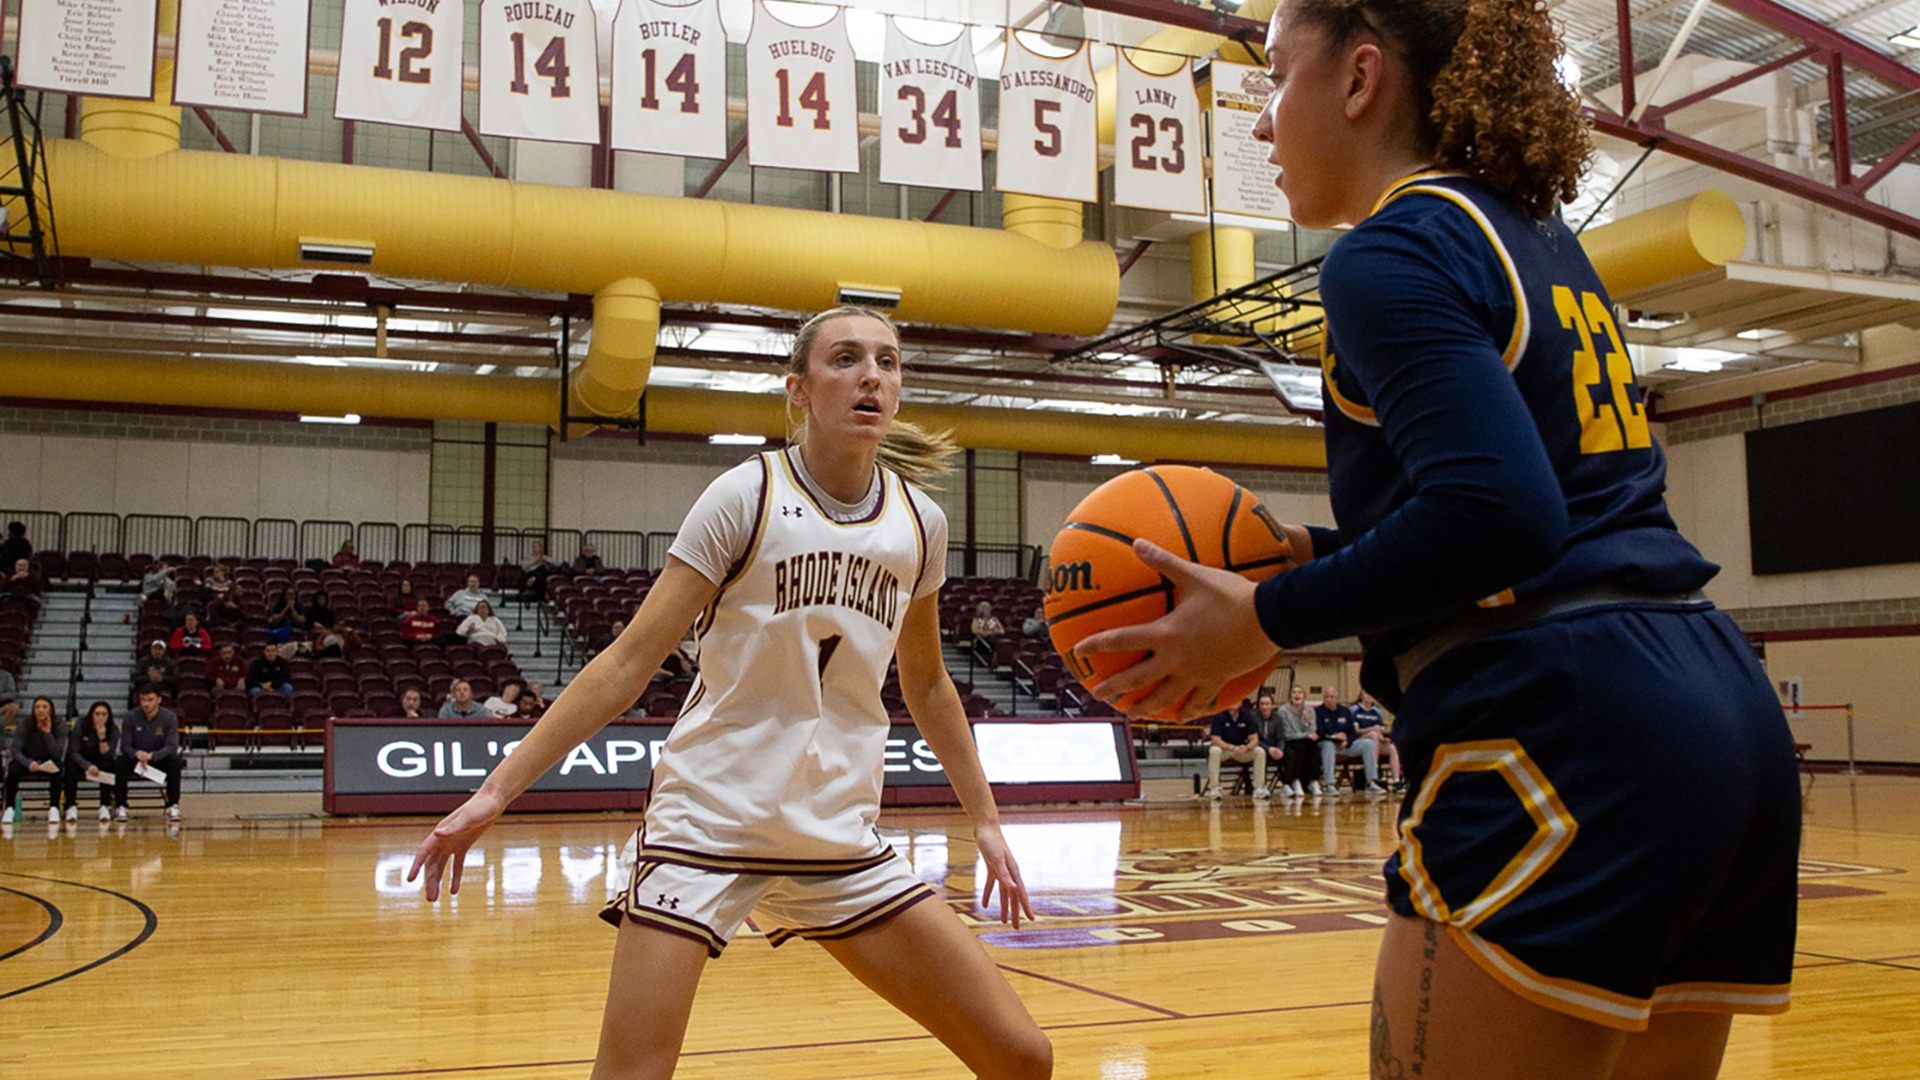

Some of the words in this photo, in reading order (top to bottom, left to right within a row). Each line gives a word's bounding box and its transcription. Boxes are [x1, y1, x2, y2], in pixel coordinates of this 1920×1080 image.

[504, 4, 575, 30] ROULEAU
[639, 20, 701, 46] BUTLER
[373, 17, 433, 85] 12
[510, 31, 571, 98] 14
[640, 48, 700, 114] 14
[768, 39, 835, 63] HUELBIG
[883, 58, 912, 80] VAN
[916, 57, 975, 90] LEESTEN
[775, 68, 831, 130] 14
[897, 85, 962, 149] 34
[1001, 69, 1095, 104] D'ALESSANDRO
[1136, 87, 1178, 110] LANNI
[1033, 98, 1062, 157] 5
[1130, 113, 1185, 174] 23
[1552, 285, 1652, 454] 22
[773, 552, 843, 615] RHODE
[841, 553, 898, 631] ISLAND
